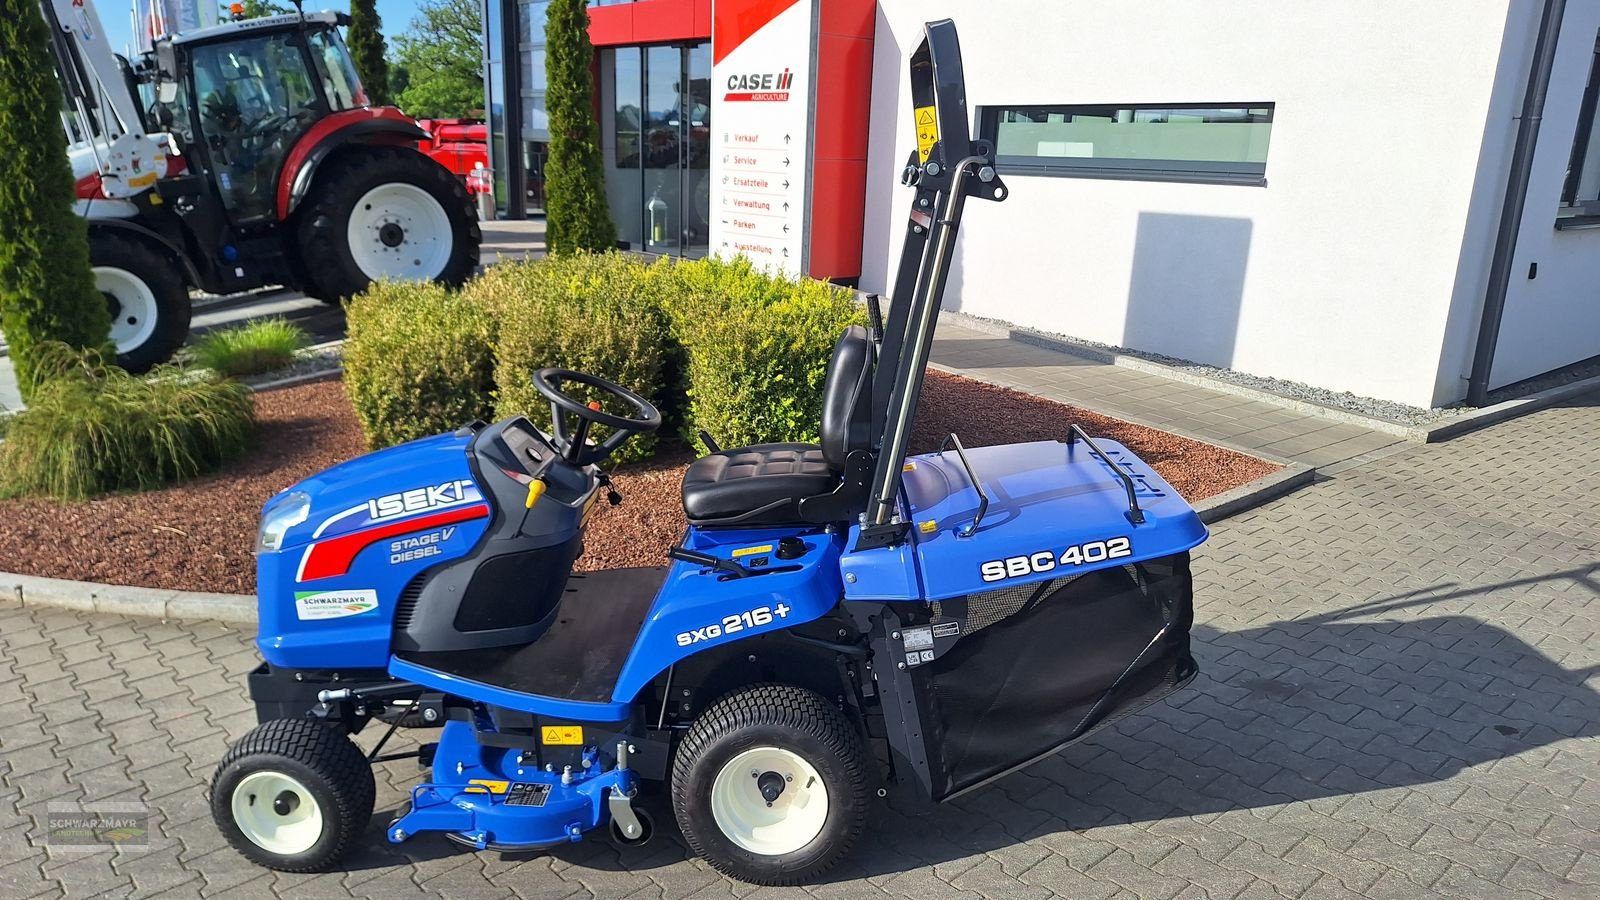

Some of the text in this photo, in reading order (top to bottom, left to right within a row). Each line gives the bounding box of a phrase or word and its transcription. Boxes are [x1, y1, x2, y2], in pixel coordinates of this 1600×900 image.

[727, 74, 773, 91] CASE
[751, 93, 788, 101] AGRICULTURE
[734, 134, 759, 143] Verkauf
[734, 155, 757, 165] Service
[733, 177, 769, 188] Ersatzteile
[733, 198, 770, 211] Verwaltung
[733, 219, 756, 230] Parken
[367, 480, 466, 519] ISEKI
[391, 527, 455, 552] STAGE V
[390, 547, 441, 564] DIESEL
[981, 536, 1132, 583] SBC 402
[304, 596, 366, 605] SCHWARZMAYR
[676, 624, 722, 647] SXG
